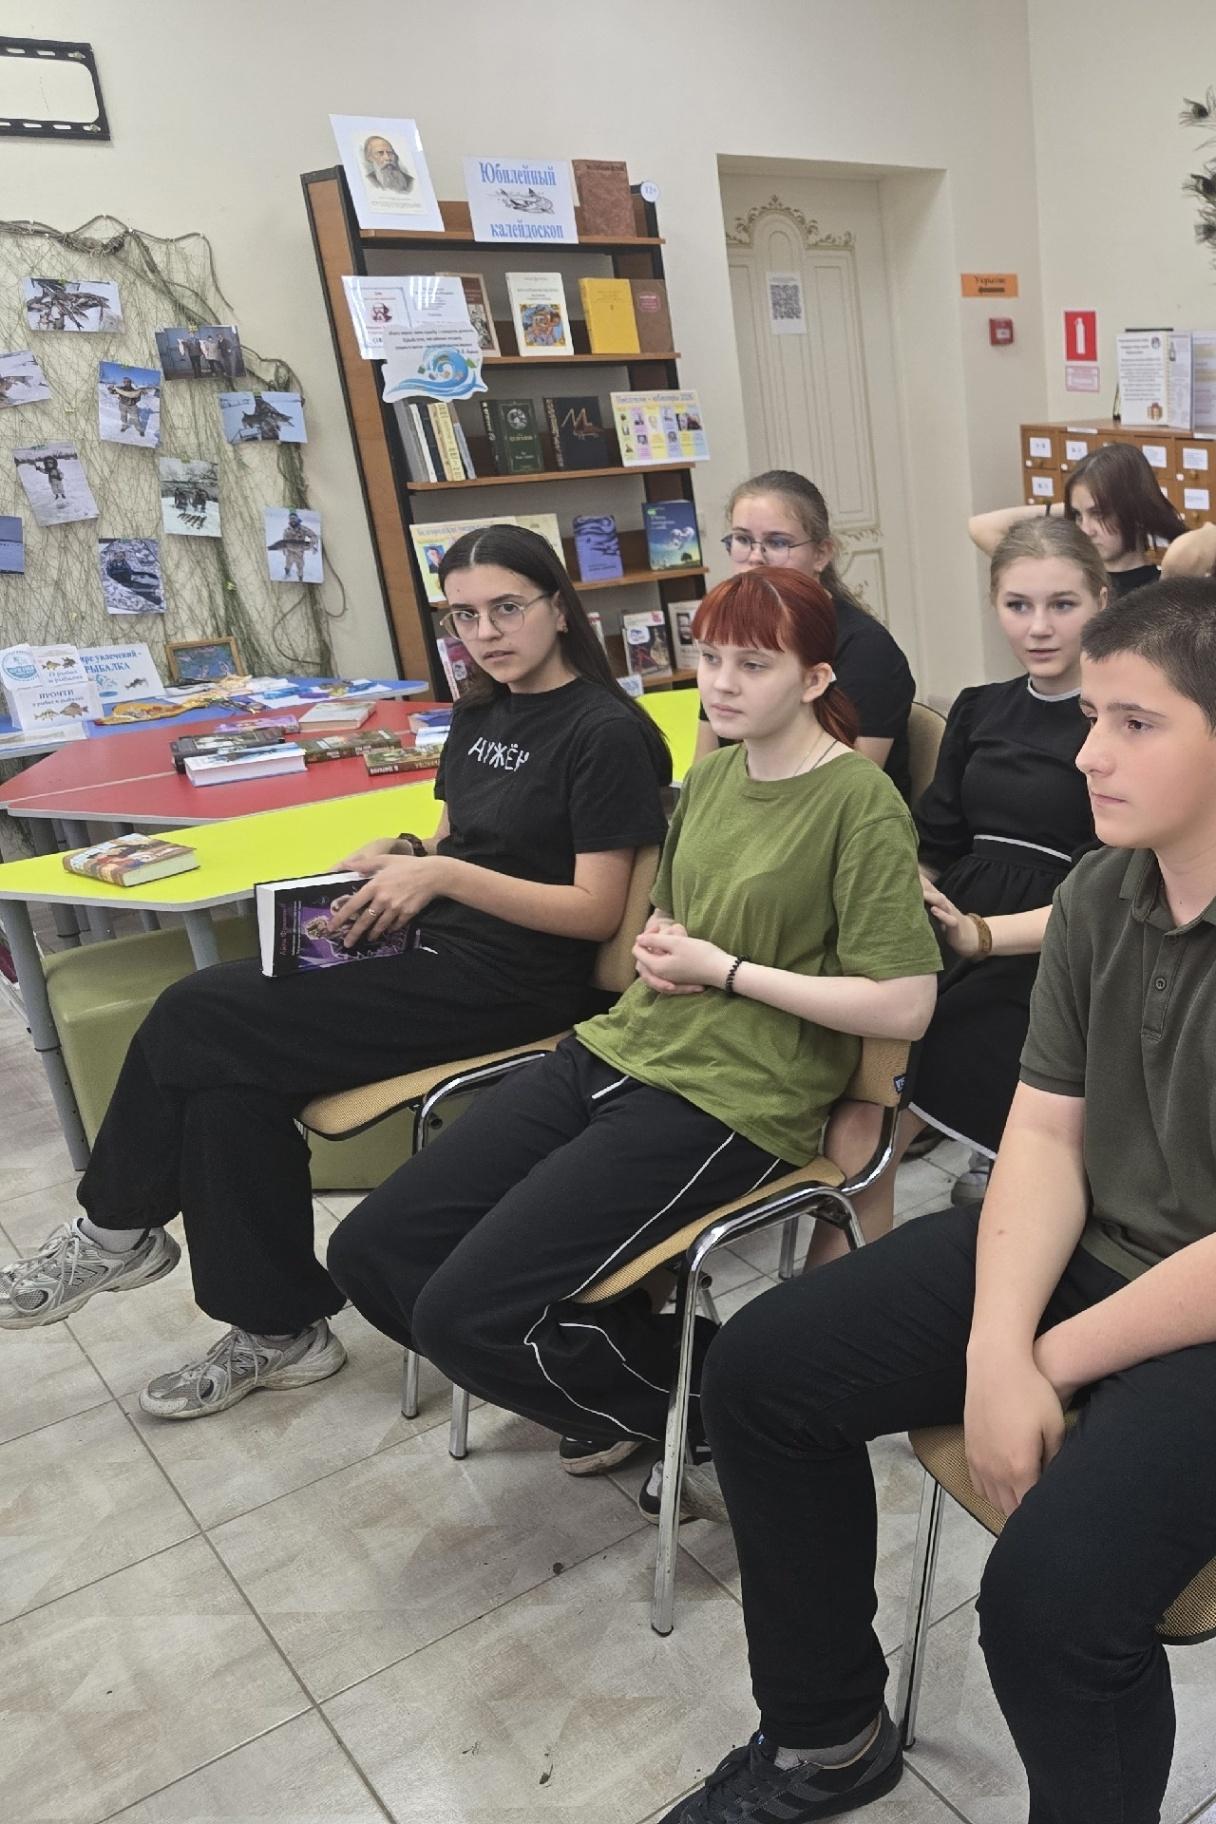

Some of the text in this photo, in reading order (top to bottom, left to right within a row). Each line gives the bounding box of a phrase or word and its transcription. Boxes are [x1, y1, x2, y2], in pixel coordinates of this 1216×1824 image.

[479, 161, 557, 186] Юбилейный
[490, 220, 564, 241] калейдоскоп
[85, 662, 131, 674] РЫБАЛКА
